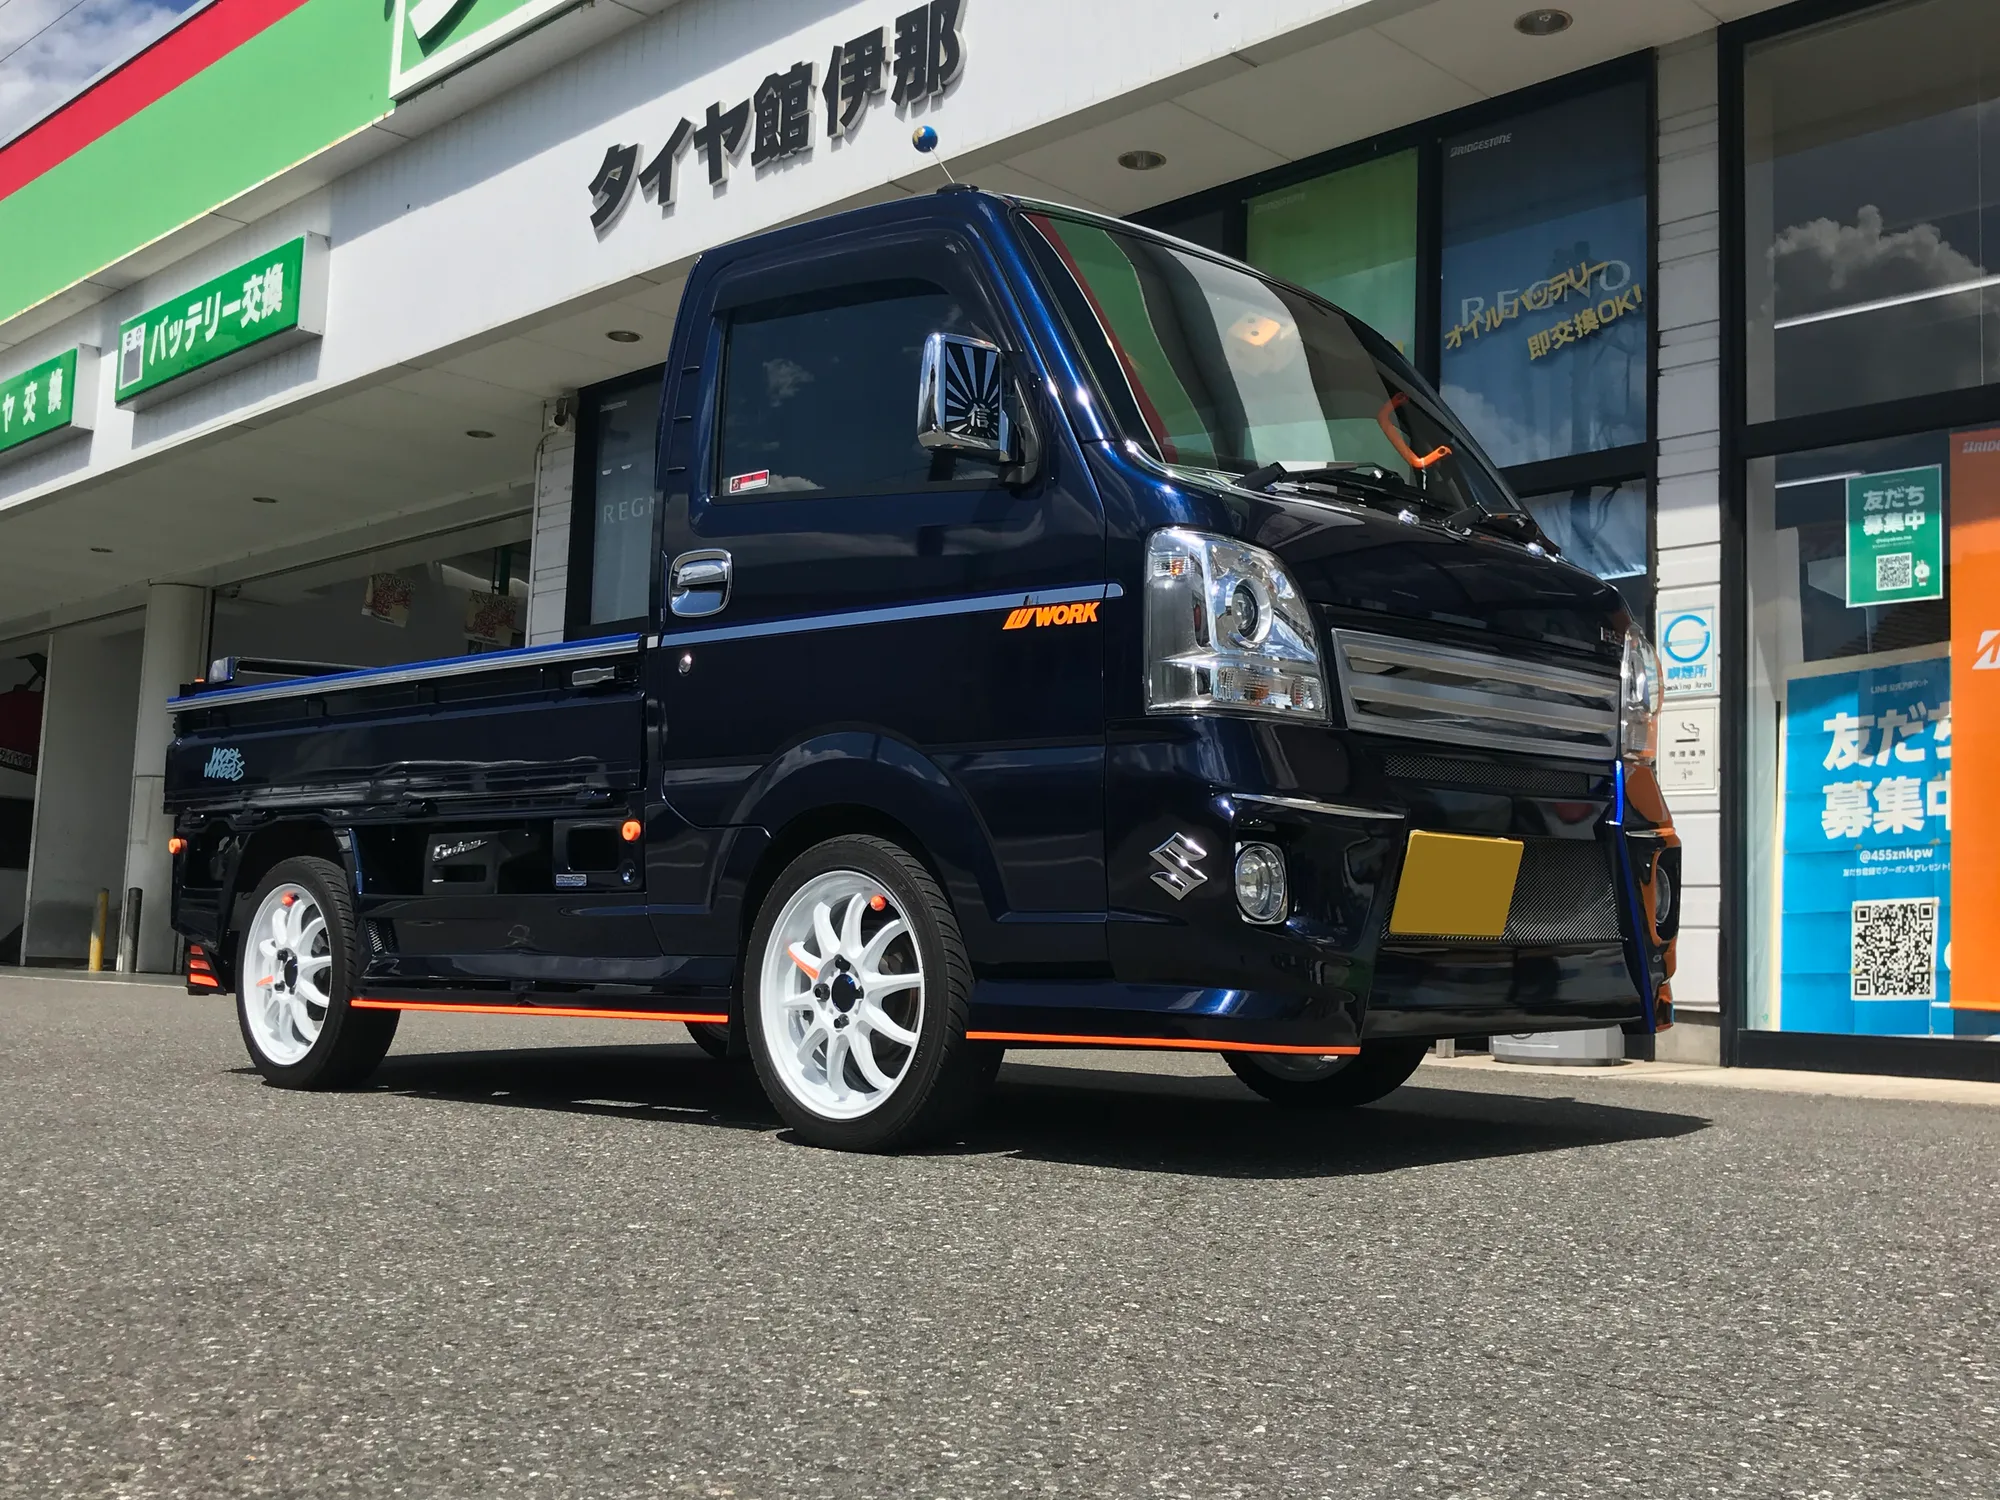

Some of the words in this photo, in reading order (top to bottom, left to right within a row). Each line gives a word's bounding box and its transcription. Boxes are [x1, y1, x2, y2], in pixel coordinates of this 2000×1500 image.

[588, 0, 964, 231] タイヤ館伊那
[1449, 133, 1512, 158] BRIDGESTONE
[149, 262, 284, 367] バッテリー交換
[968, 402, 990, 429] 信
[1963, 440, 2000, 453] BRID
[1863, 485, 1925, 511] 友だち
[1036, 602, 1101, 628] WORK
[1860, 847, 1933, 863] @455znkpw
